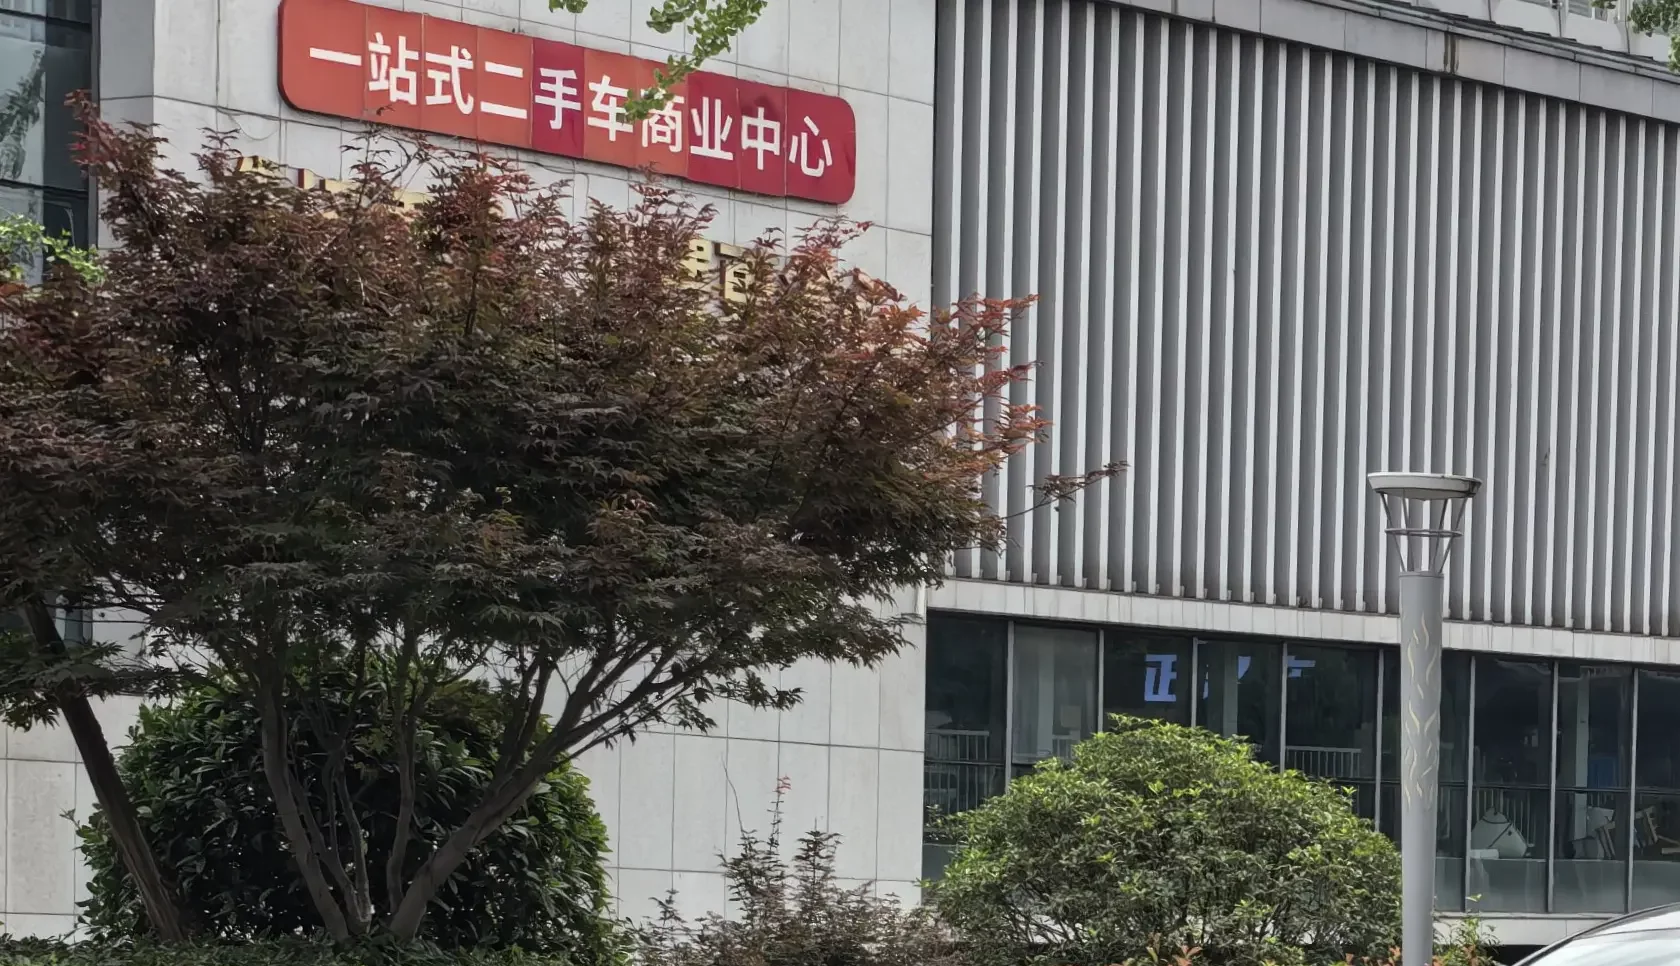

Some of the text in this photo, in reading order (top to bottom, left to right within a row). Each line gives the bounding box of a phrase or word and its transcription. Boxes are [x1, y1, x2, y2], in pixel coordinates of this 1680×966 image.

[309, 31, 833, 178] 一站式二手车商业中心
